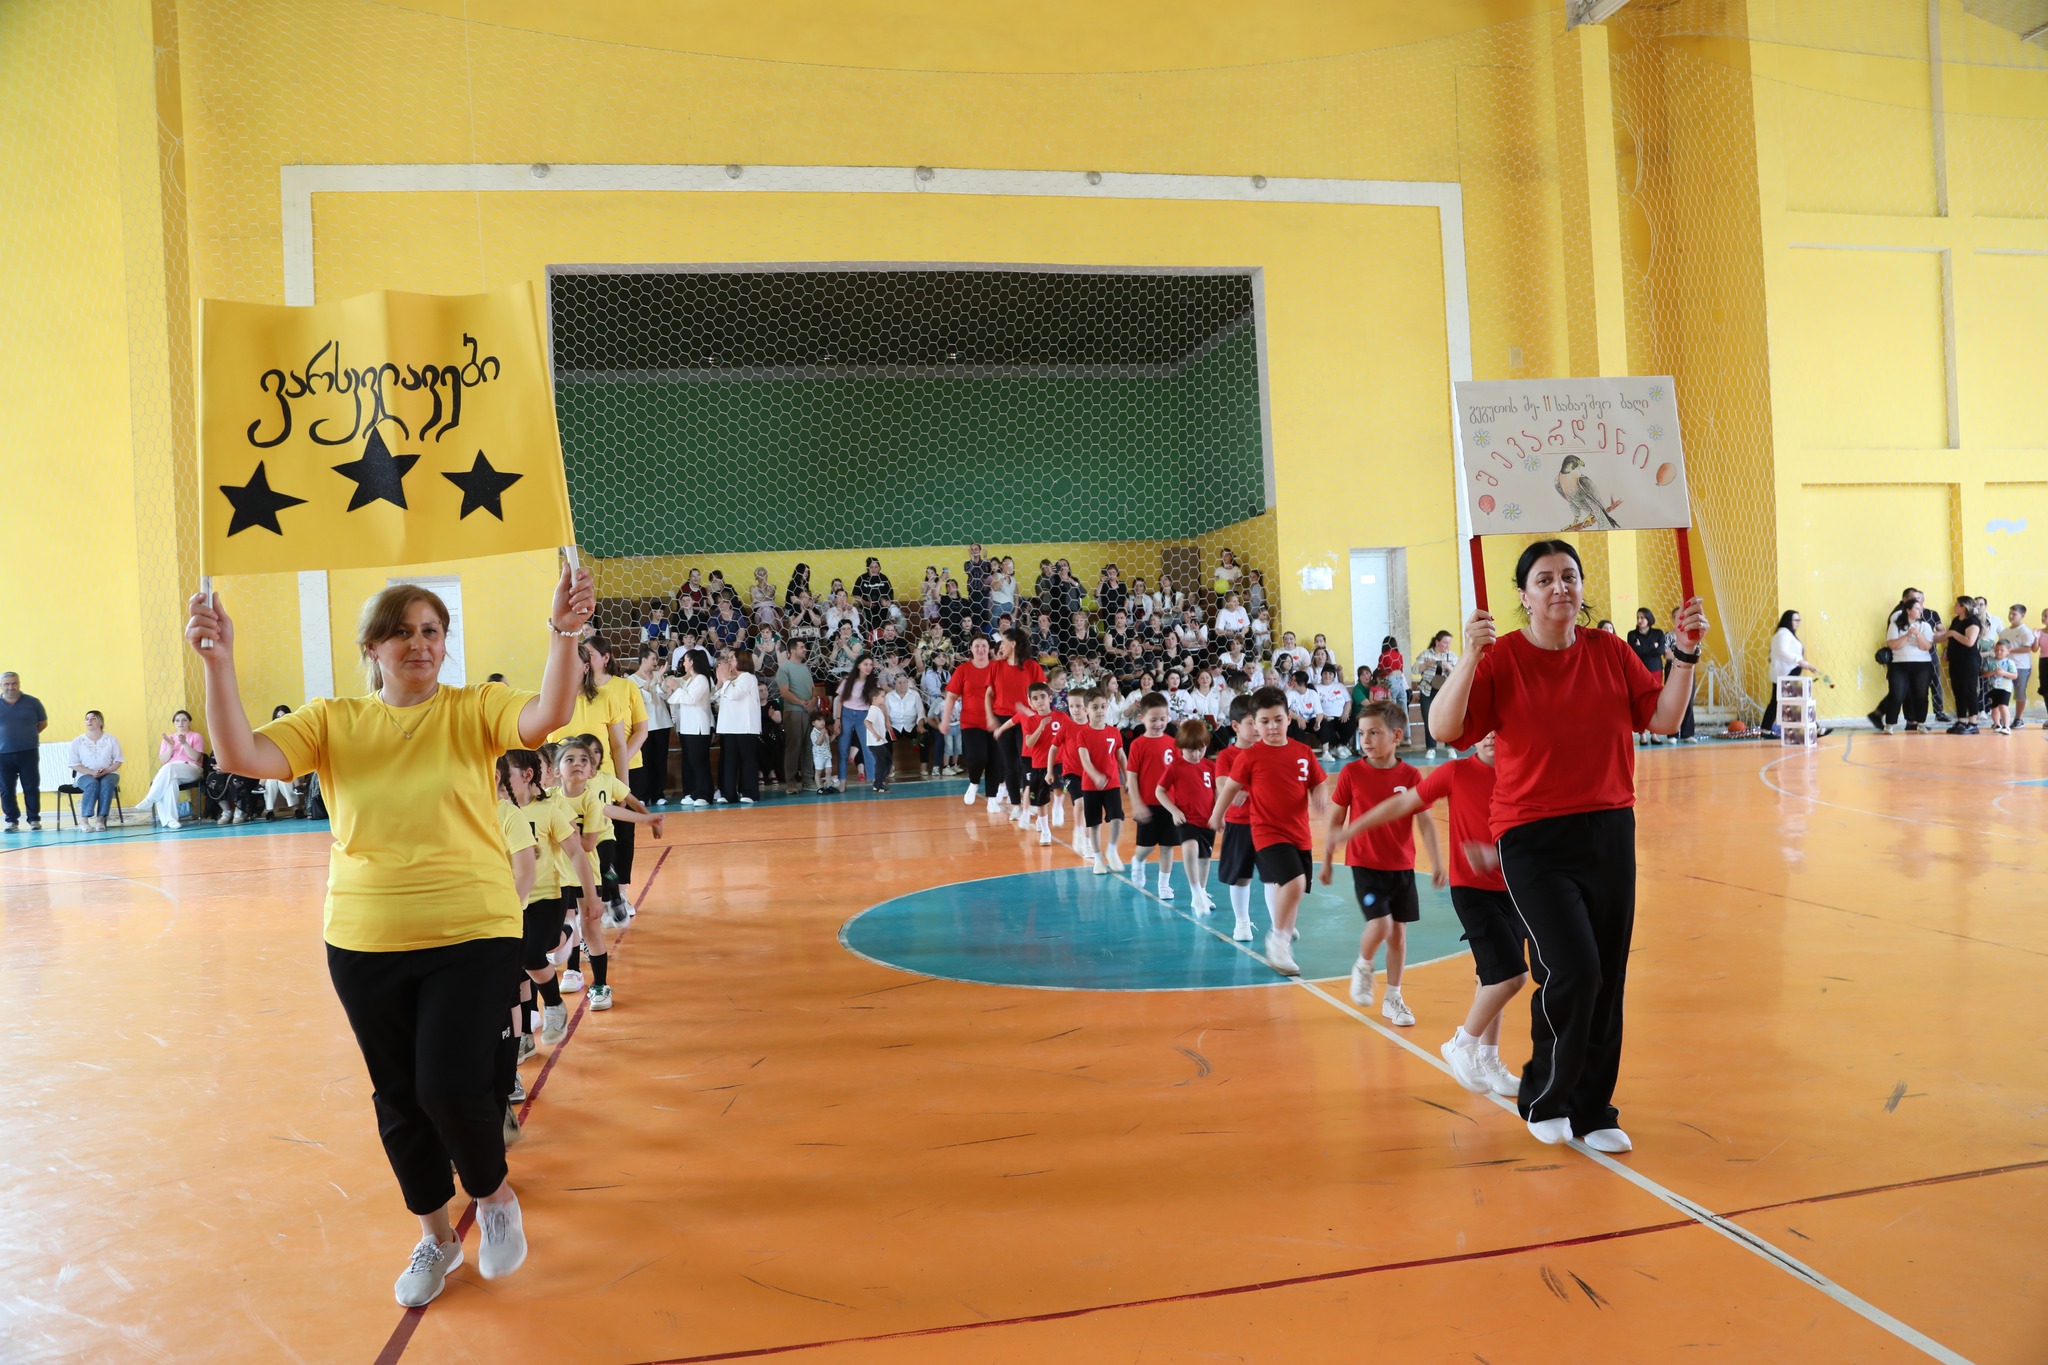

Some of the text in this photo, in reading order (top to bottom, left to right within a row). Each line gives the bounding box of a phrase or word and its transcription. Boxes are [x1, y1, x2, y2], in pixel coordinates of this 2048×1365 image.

[247, 333, 501, 447] ვარსკვლავები
[1553, 394, 1612, 420] საბავშვო
[1620, 392, 1649, 416] ბაღი
[1106, 738, 1116, 754] 7
[1164, 748, 1174, 765] 6
[1203, 771, 1212, 788] 5
[1296, 758, 1310, 781] 3
